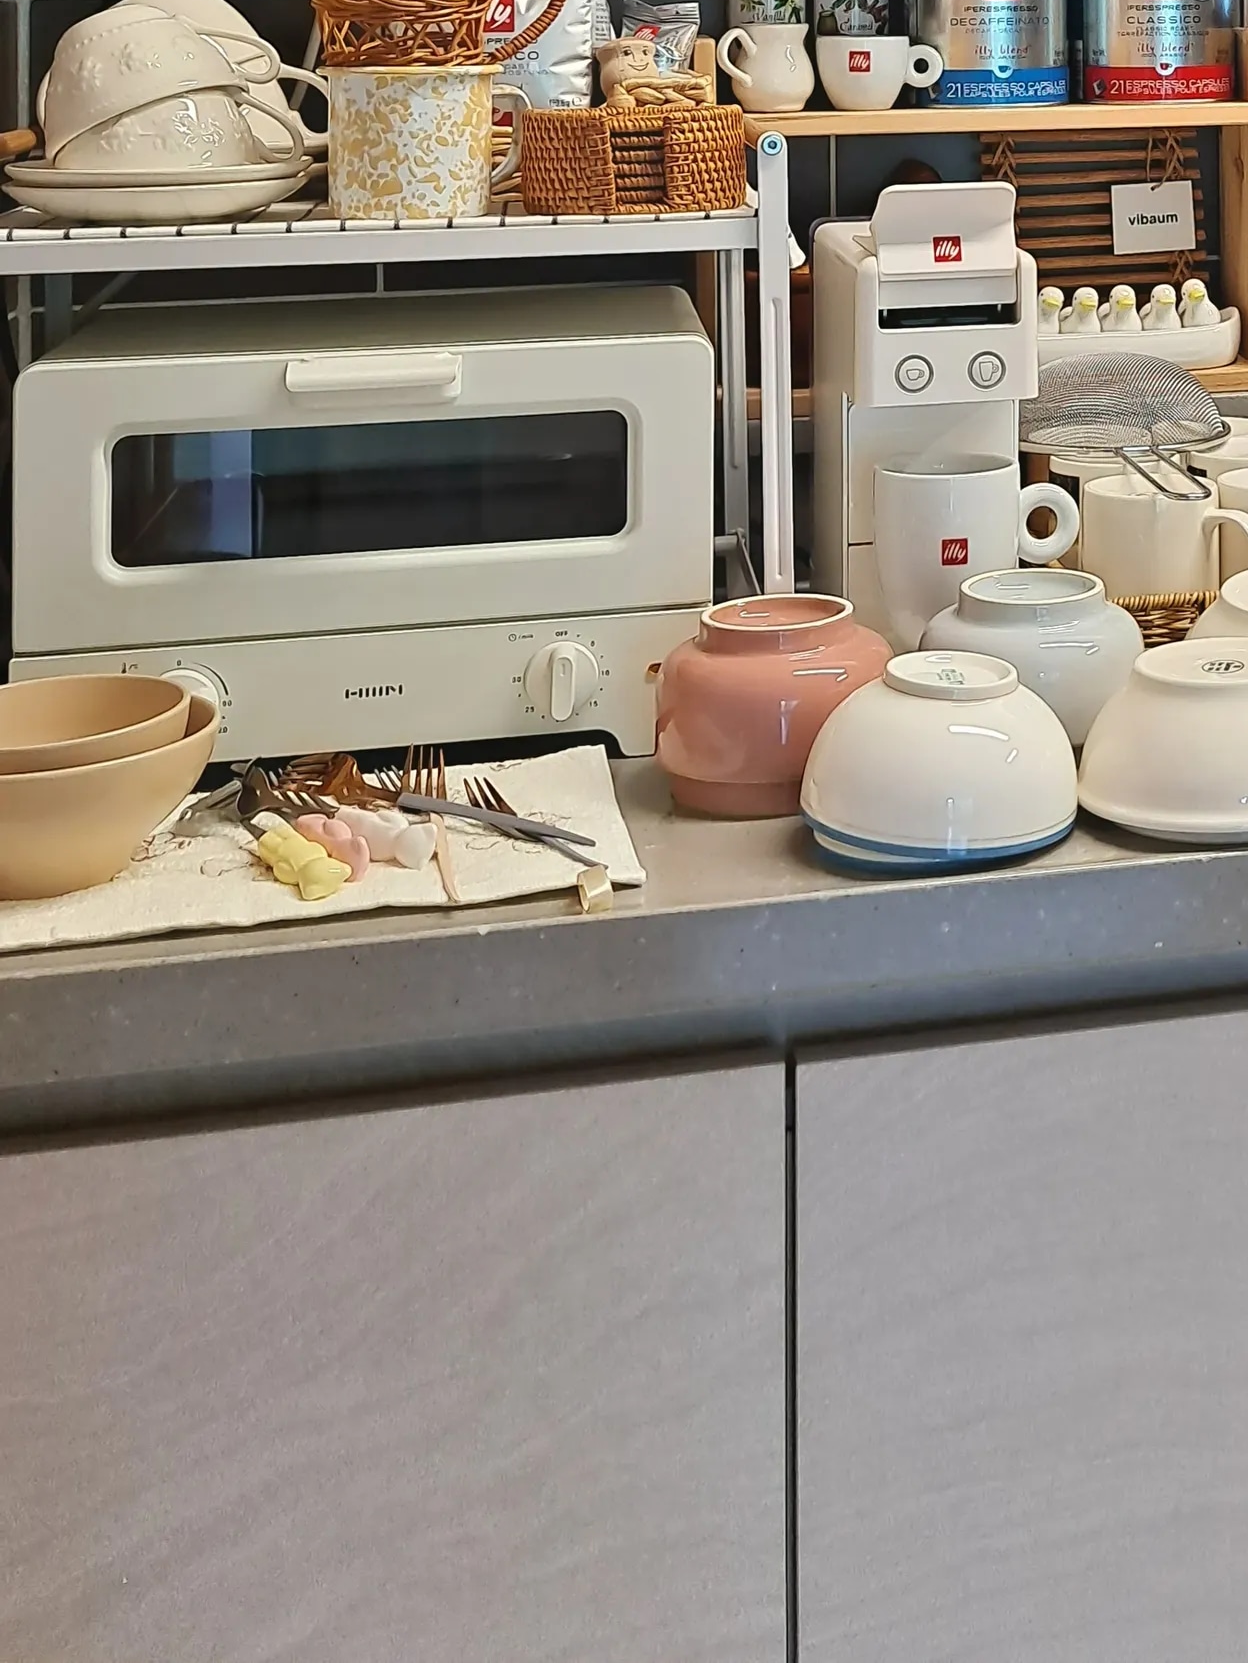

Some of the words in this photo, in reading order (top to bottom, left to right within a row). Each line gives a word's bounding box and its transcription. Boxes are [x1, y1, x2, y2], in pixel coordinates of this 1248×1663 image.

[951, 17, 1050, 27] DECAFFEINATO
[1127, 16, 1201, 24] CLASSICO
[1137, 42, 1155, 53] illy
[1161, 42, 1191, 52] blend
[850, 53, 870, 69] illy
[963, 82, 1026, 91] ESPRESSO
[1110, 79, 1124, 94] 21
[1126, 79, 1187, 88] ESPRESSO
[946, 83, 962, 98] 21
[1128, 213, 1179, 226] vibaum
[935, 240, 960, 260] illy
[943, 542, 967, 563] illy
[589, 700, 598, 708] 15
